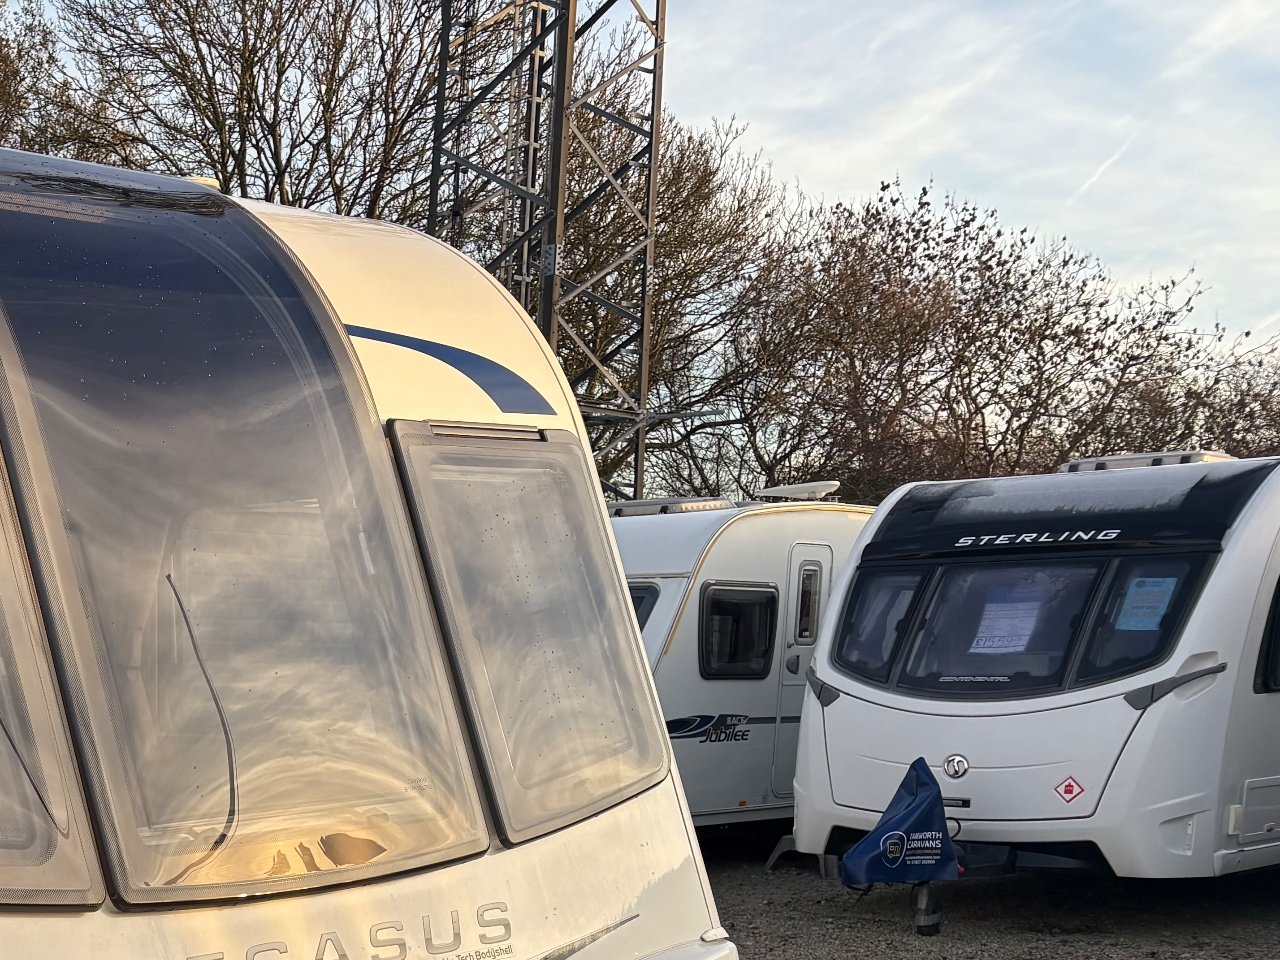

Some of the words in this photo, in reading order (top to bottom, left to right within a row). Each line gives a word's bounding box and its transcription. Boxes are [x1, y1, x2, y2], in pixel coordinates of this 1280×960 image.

[954, 529, 1122, 547] STERLING
[699, 726, 751, 743] Jubilee
[907, 840, 942, 849] CARAVANS
[475, 944, 514, 960] Bodyshell
